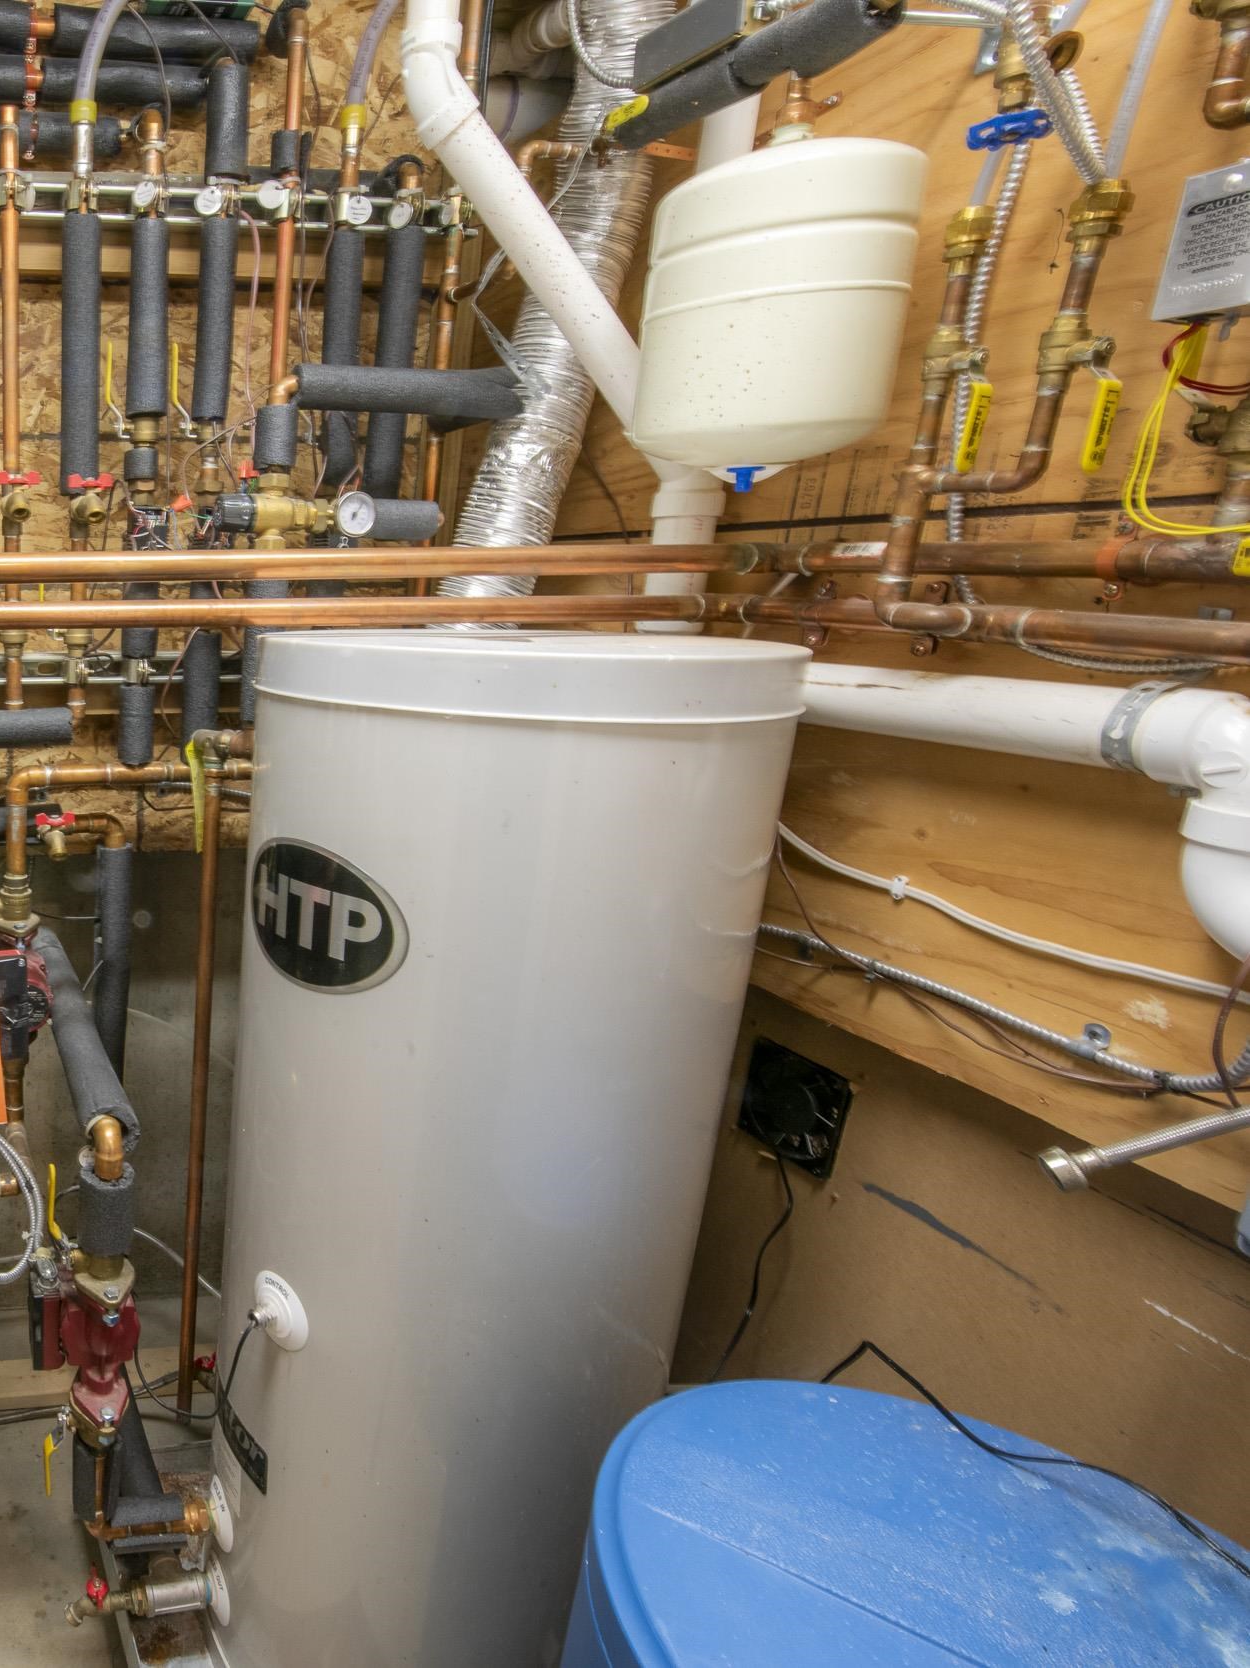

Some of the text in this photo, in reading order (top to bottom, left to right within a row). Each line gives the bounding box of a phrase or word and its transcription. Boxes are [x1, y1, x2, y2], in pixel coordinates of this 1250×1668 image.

[1206, 206, 1236, 219] HAZARD
[1191, 215, 1230, 231] ELECTRICAL
[1215, 221, 1236, 232] THAN
[1184, 229, 1230, 247] DISCONNECT
[1210, 234, 1244, 248] REQUIRED
[257, 863, 382, 962] HTP
[264, 1276, 290, 1300] CONTROL
